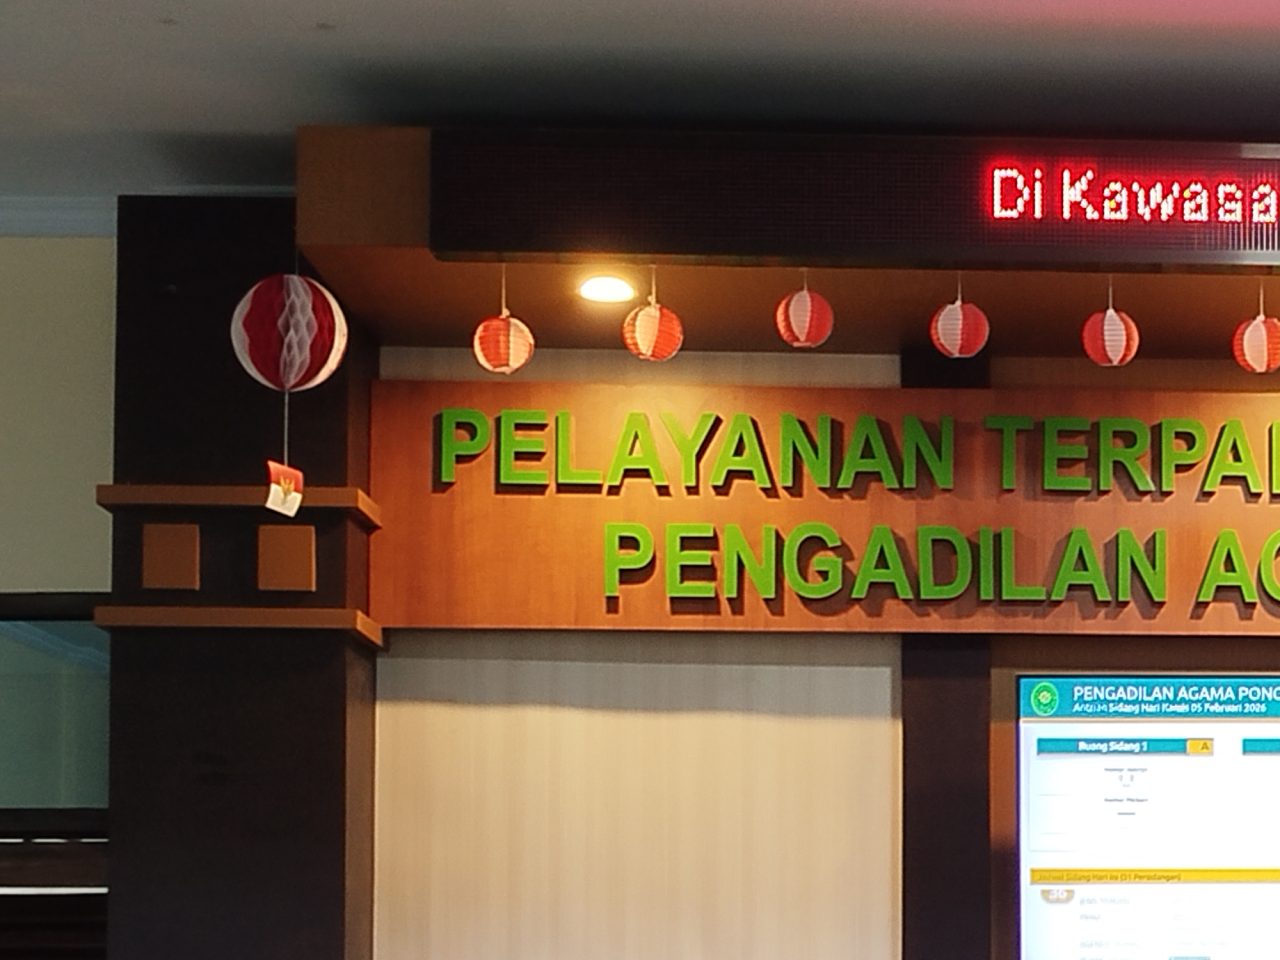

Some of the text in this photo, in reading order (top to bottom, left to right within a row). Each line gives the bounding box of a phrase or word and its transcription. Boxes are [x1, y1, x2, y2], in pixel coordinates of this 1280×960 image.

[991, 167, 1044, 220] Di
[440, 408, 955, 491] PELAYANAN
[604, 523, 1168, 603] PENGADILAN
[1073, 685, 1174, 701] PENGADILAN
[1177, 685, 1236, 701] AGAMA
[1109, 703, 1139, 714] Sidang
[1141, 703, 1160, 713] Hari
[1204, 703, 1242, 713] Februari
[1244, 703, 1267, 713] 2026
[1201, 741, 1209, 751] A
